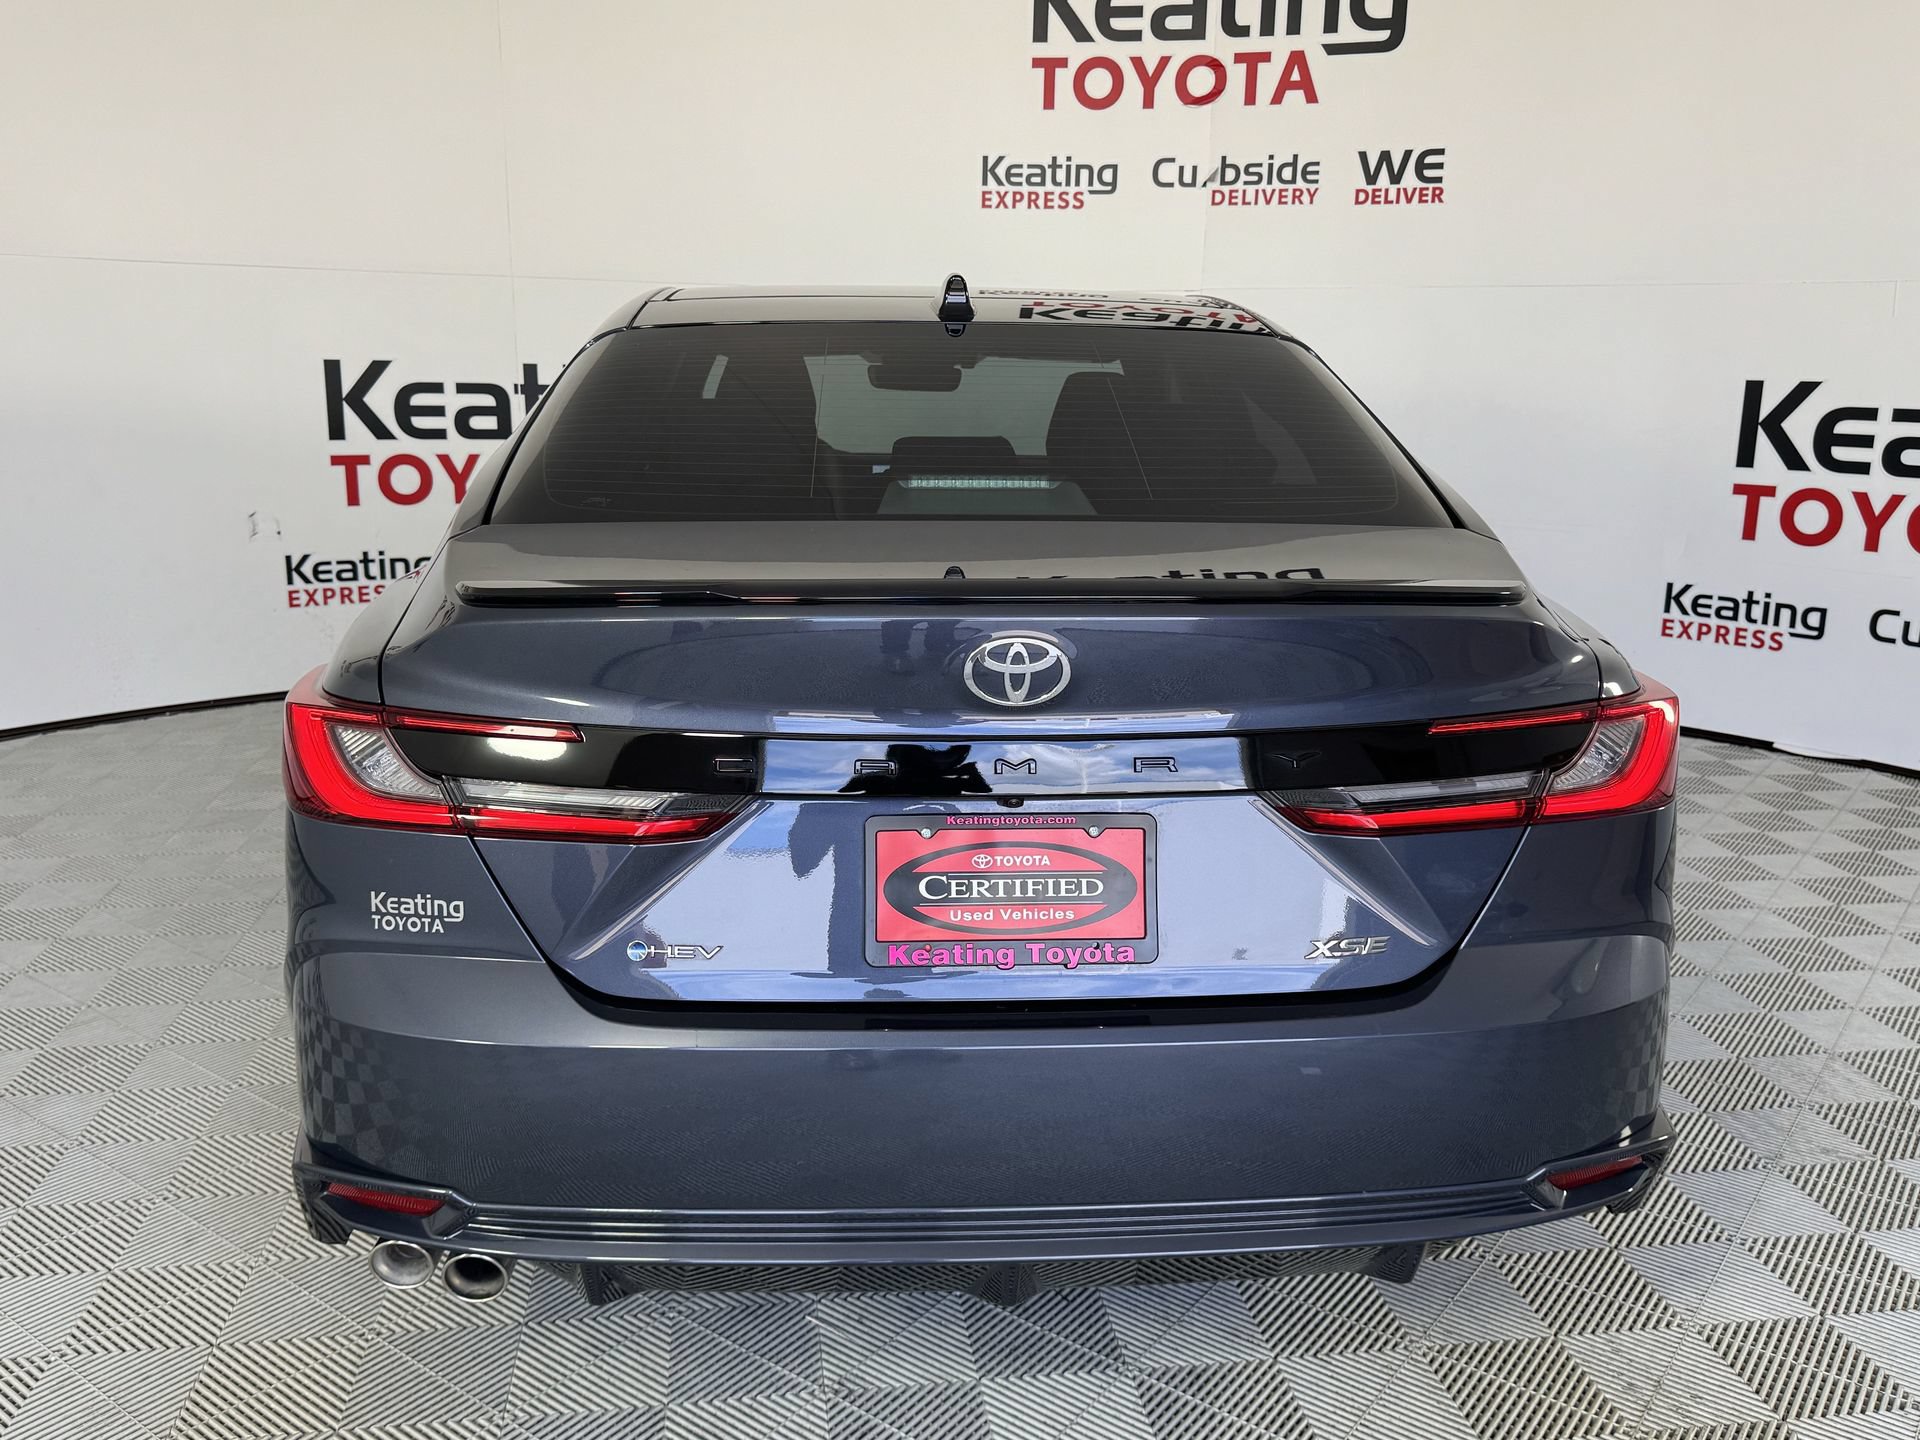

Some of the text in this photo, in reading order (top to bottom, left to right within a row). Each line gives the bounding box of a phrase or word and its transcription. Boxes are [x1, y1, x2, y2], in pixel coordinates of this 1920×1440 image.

[1031, 50, 1319, 111] TOYOTA
[981, 156, 1118, 195] Keating
[1152, 154, 1320, 188] Cubside
[1358, 148, 1446, 184] WE
[981, 191, 1085, 209] EXPRESS
[1210, 188, 1319, 206] DELIVERY
[1354, 187, 1445, 205] DELIVER
[1735, 380, 1920, 479] Kea
[330, 454, 480, 507] TOY
[1732, 483, 1920, 555] TOY
[1663, 582, 1828, 640] Keating
[1660, 618, 1784, 652] EXPRESS
[946, 816, 1076, 826] Keatingtoyota.com
[994, 855, 1050, 867] TOYOTA
[918, 876, 1104, 900] CERTIFIED
[370, 891, 464, 922] Keating
[950, 908, 1075, 921] Used Vehicles
[371, 915, 444, 933] TOYOTA
[887, 943, 1136, 969] Keating Toyota
[1304, 936, 1391, 960] XSE
